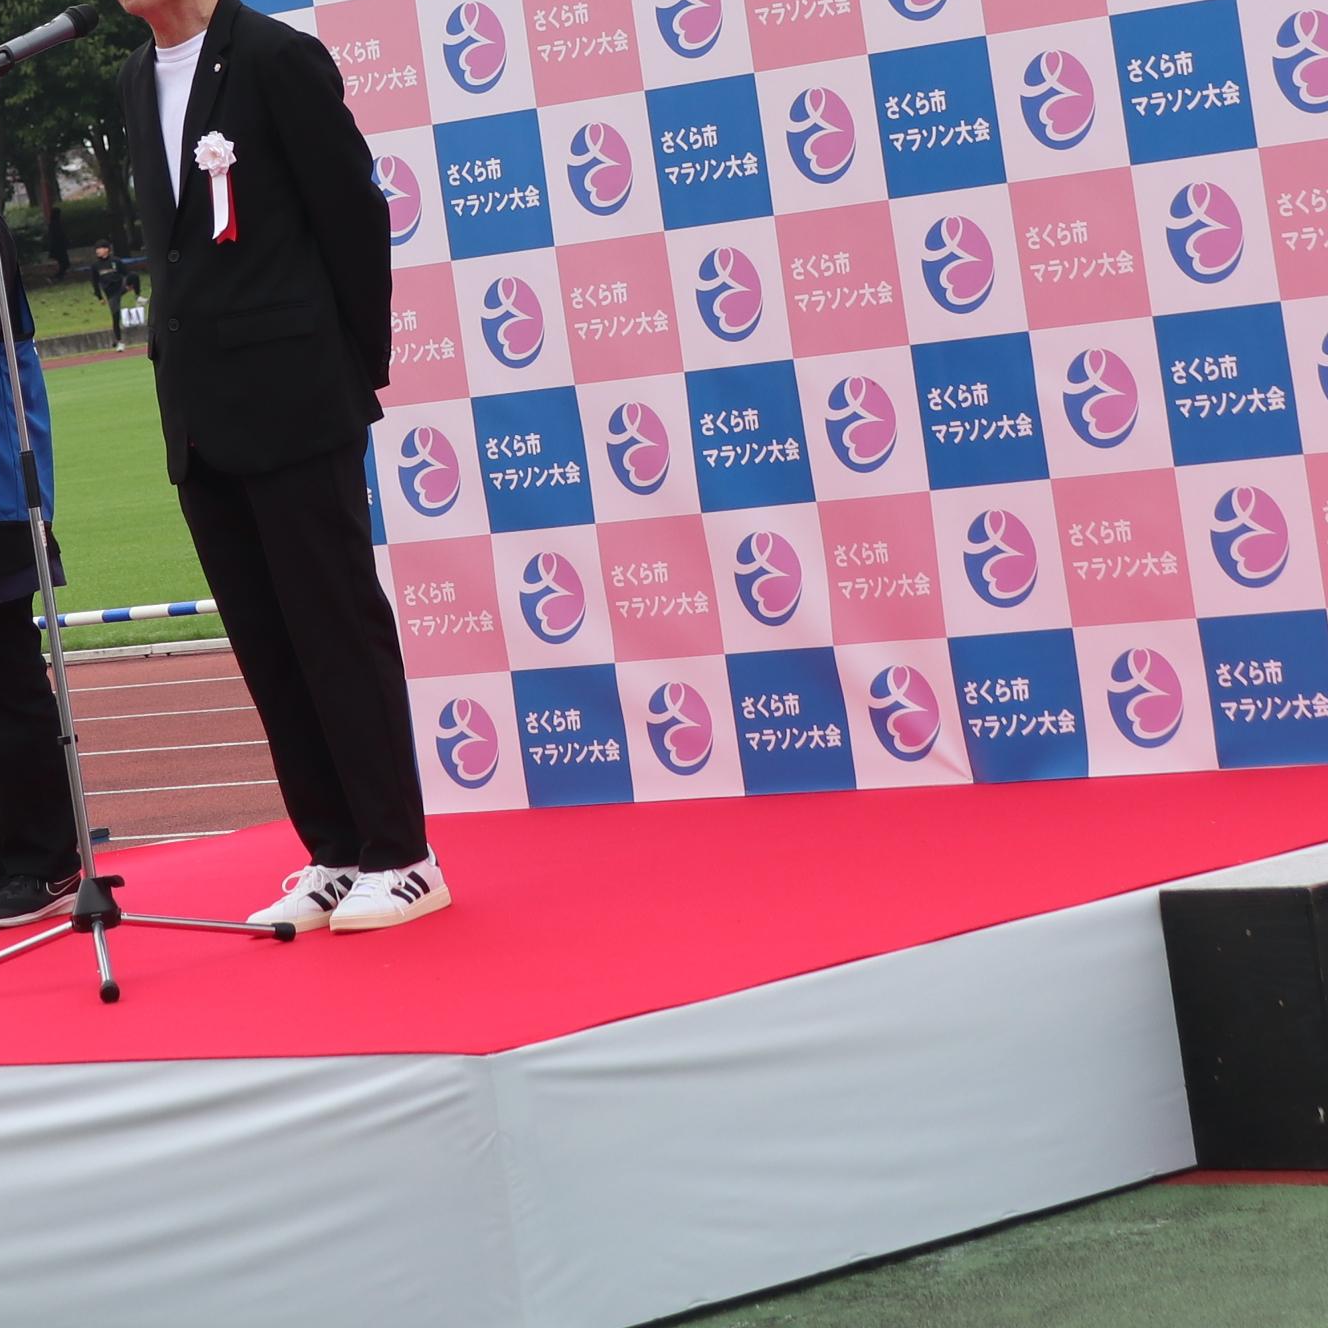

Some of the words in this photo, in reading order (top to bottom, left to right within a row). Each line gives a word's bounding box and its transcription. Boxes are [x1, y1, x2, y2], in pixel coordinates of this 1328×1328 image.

[533, 2, 590, 32] さくら市
[537, 28, 629, 62] マラソン大会
[343, 65, 417, 96] ラソン大会
[1128, 51, 1194, 83] さくら市
[885, 89, 947, 120] さくら市
[1131, 80, 1241, 115] マラソン大会
[661, 124, 718, 154] さくら市
[890, 118, 991, 151] マラソン大会
[447, 158, 502, 186] さくら市
[664, 151, 759, 184] マラソン大会
[451, 185, 540, 216] マラソン大会
[1025, 219, 1089, 250] さくら市
[791, 251, 851, 281] さくら市
[1030, 249, 1134, 282] マラソン大会
[570, 280, 628, 310] さくら市
[793, 281, 893, 313] マラソン大会
[391, 310, 417, 333] ら市
[574, 309, 669, 340] マラソン大会
[389, 337, 455, 366] ソン大会
[1171, 355, 1238, 385] さくら市
[927, 382, 989, 411] さくら市
[1175, 386, 1286, 418] マラソン大会
[700, 409, 760, 436] さくら市
[931, 412, 1034, 444] マラソン大会
[486, 433, 542, 460] さくら市
[703, 437, 801, 467] マラソン大会
[489, 461, 581, 490] マラソン大会
[1069, 519, 1133, 548] さくら市
[834, 541, 889, 568] さくら市
[1071, 551, 1179, 579] マラソン大会
[610, 560, 669, 588] さくら市
[838, 571, 931, 599] マラソン大会
[403, 580, 456, 607] さくら市
[615, 591, 710, 618] マラソン大会
[406, 611, 494, 637] マラソン大会
[1216, 660, 1283, 688] さくら市
[964, 678, 1030, 705] さくら市
[742, 694, 801, 720] さくら市
[526, 709, 581, 735] さくら市
[972, 709, 1076, 738] マラソン大会
[746, 724, 842, 751] マラソン大会
[529, 740, 621, 765] マラソン大会
